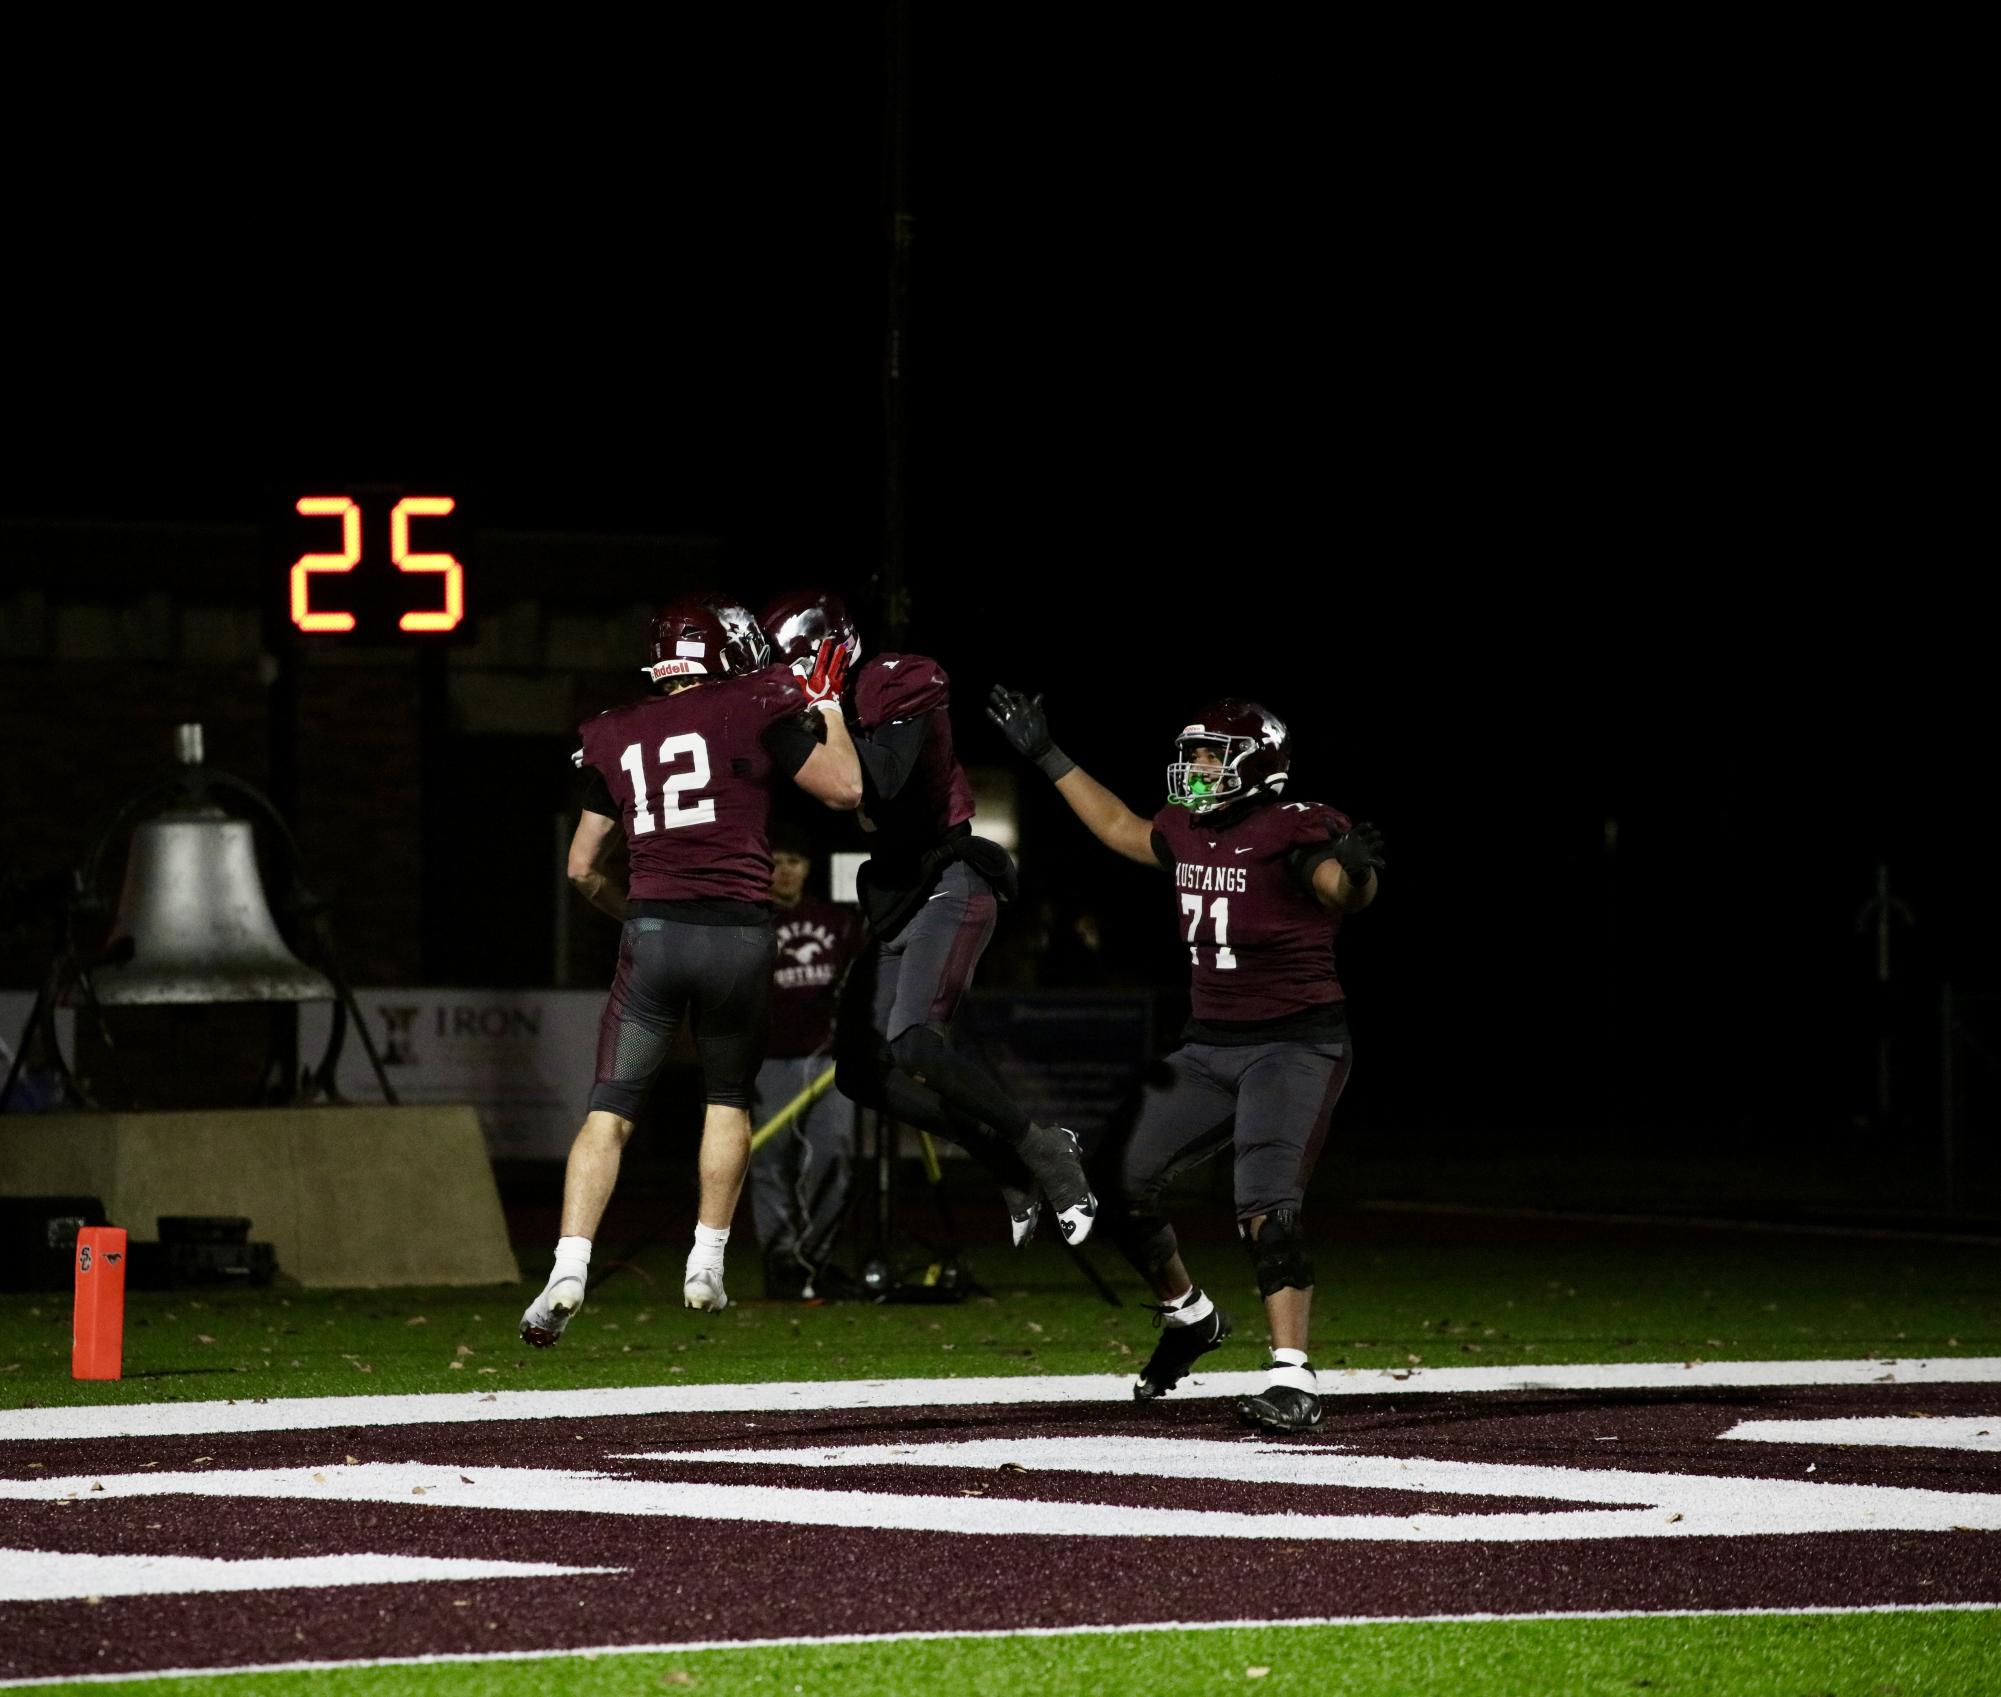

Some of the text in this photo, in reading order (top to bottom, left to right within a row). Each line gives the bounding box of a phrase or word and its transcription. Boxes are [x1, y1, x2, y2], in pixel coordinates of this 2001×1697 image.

[291, 497, 463, 632] 25
[653, 662, 690, 679] Riddell
[620, 732, 716, 835] 12
[1181, 893, 1237, 969] 71
[435, 1006, 543, 1036] IRON
